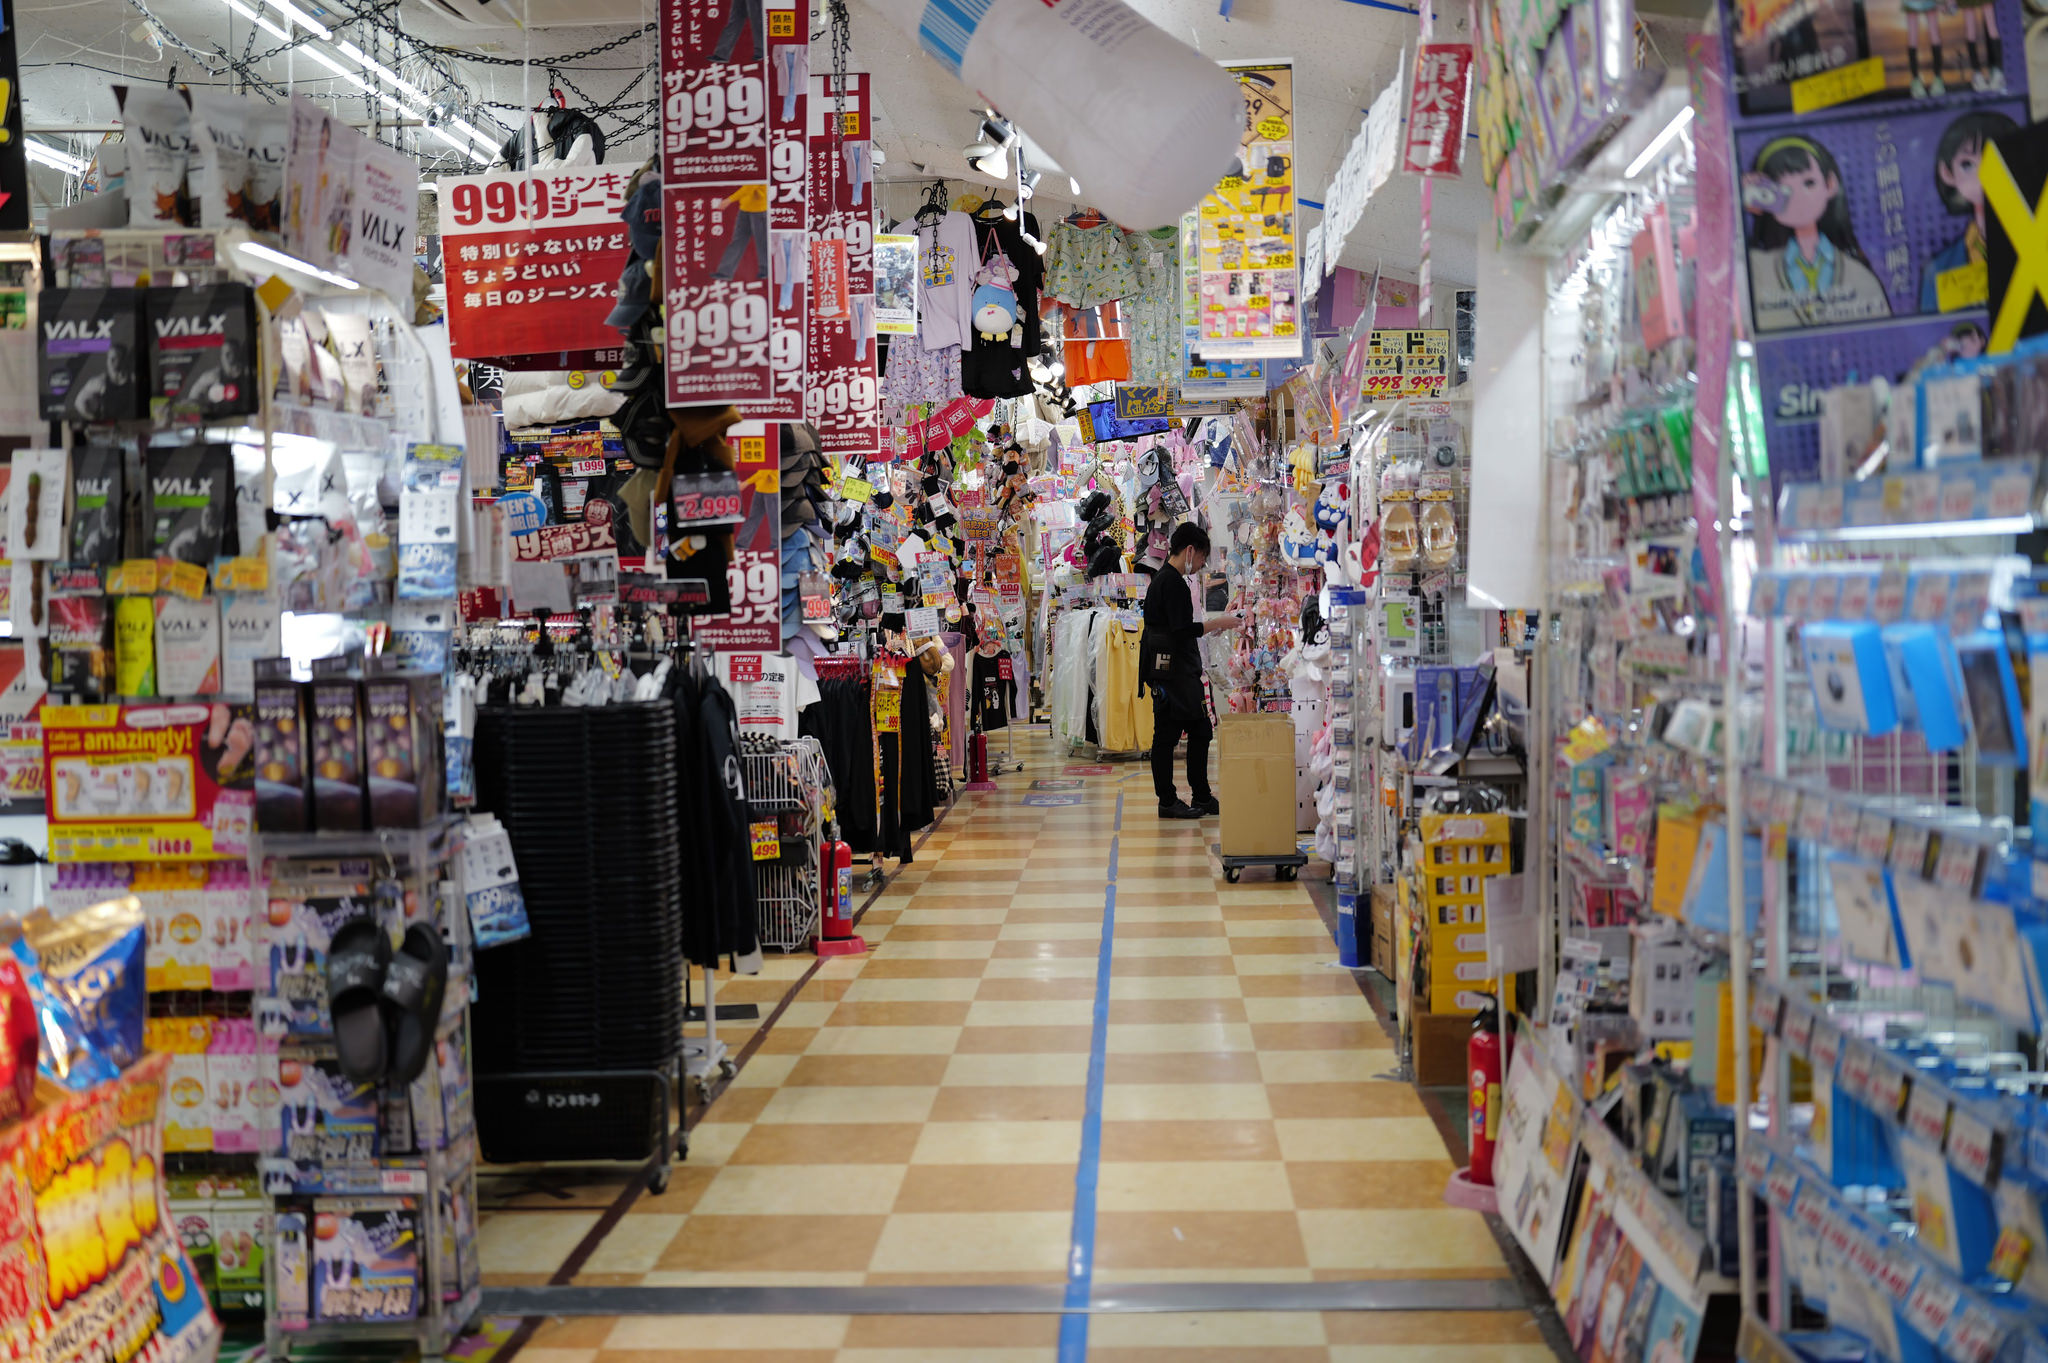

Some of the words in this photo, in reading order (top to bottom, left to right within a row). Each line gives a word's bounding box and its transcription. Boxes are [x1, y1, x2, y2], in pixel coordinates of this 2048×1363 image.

[664, 62, 759, 95] サンキュー
[666, 77, 764, 133] 999
[1410, 52, 1459, 143] 消火器
[666, 122, 766, 153] ジーンズ
[452, 179, 549, 226] 999
[710, 198, 723, 236] 毎日の
[361, 208, 405, 252] VALX
[674, 200, 688, 284] ちょうどいい。
[692, 198, 706, 269] オシャレに、
[462, 261, 581, 285] ちょうどいい
[817, 243, 837, 306] 液体消火器
[464, 281, 619, 308] 毎日のジーンズ。
[668, 279, 763, 311] サンキュー
[44, 318, 115, 339] VALX
[155, 314, 226, 337] VALX
[669, 294, 768, 351] 999
[670, 342, 770, 372] ジーンズ
[806, 366, 872, 388] サンキュー
[1367, 375, 1404, 390] 998
[806, 376, 876, 417] 999
[949, 409, 967, 425] DIESEL
[76, 478, 112, 495] VALX
[152, 477, 214, 495] VALX
[161, 619, 210, 631] VALX
[84, 725, 193, 755] amazingly!
[754, 843, 777, 857] 499
